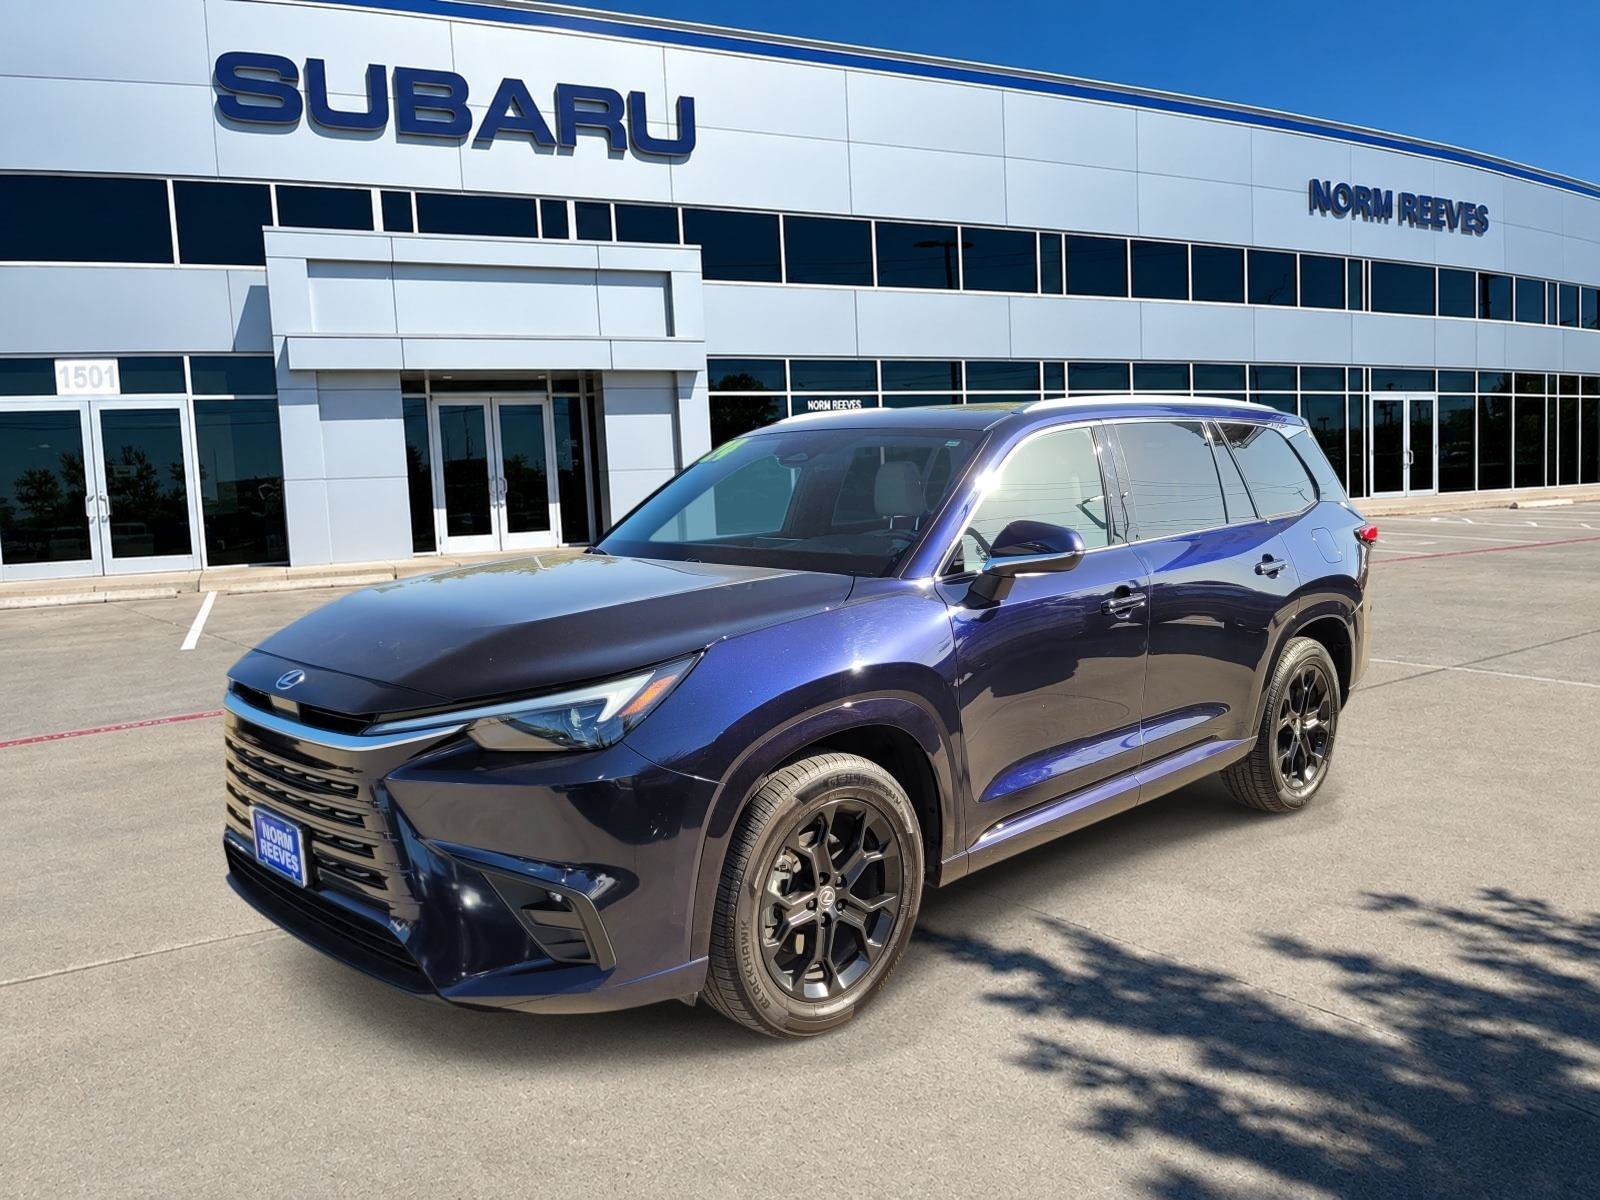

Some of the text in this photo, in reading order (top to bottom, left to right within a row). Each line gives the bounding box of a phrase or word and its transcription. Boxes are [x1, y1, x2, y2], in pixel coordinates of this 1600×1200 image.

[212, 51, 696, 156] SUBARU
[1309, 178, 1490, 233] NORM REEVES
[59, 365, 115, 389] 1501
[807, 399, 862, 411] NORM REEVES
[261, 821, 294, 854] NORM
[260, 839, 299, 873] REEVES
[740, 919, 771, 1010] BLACKHAWK
